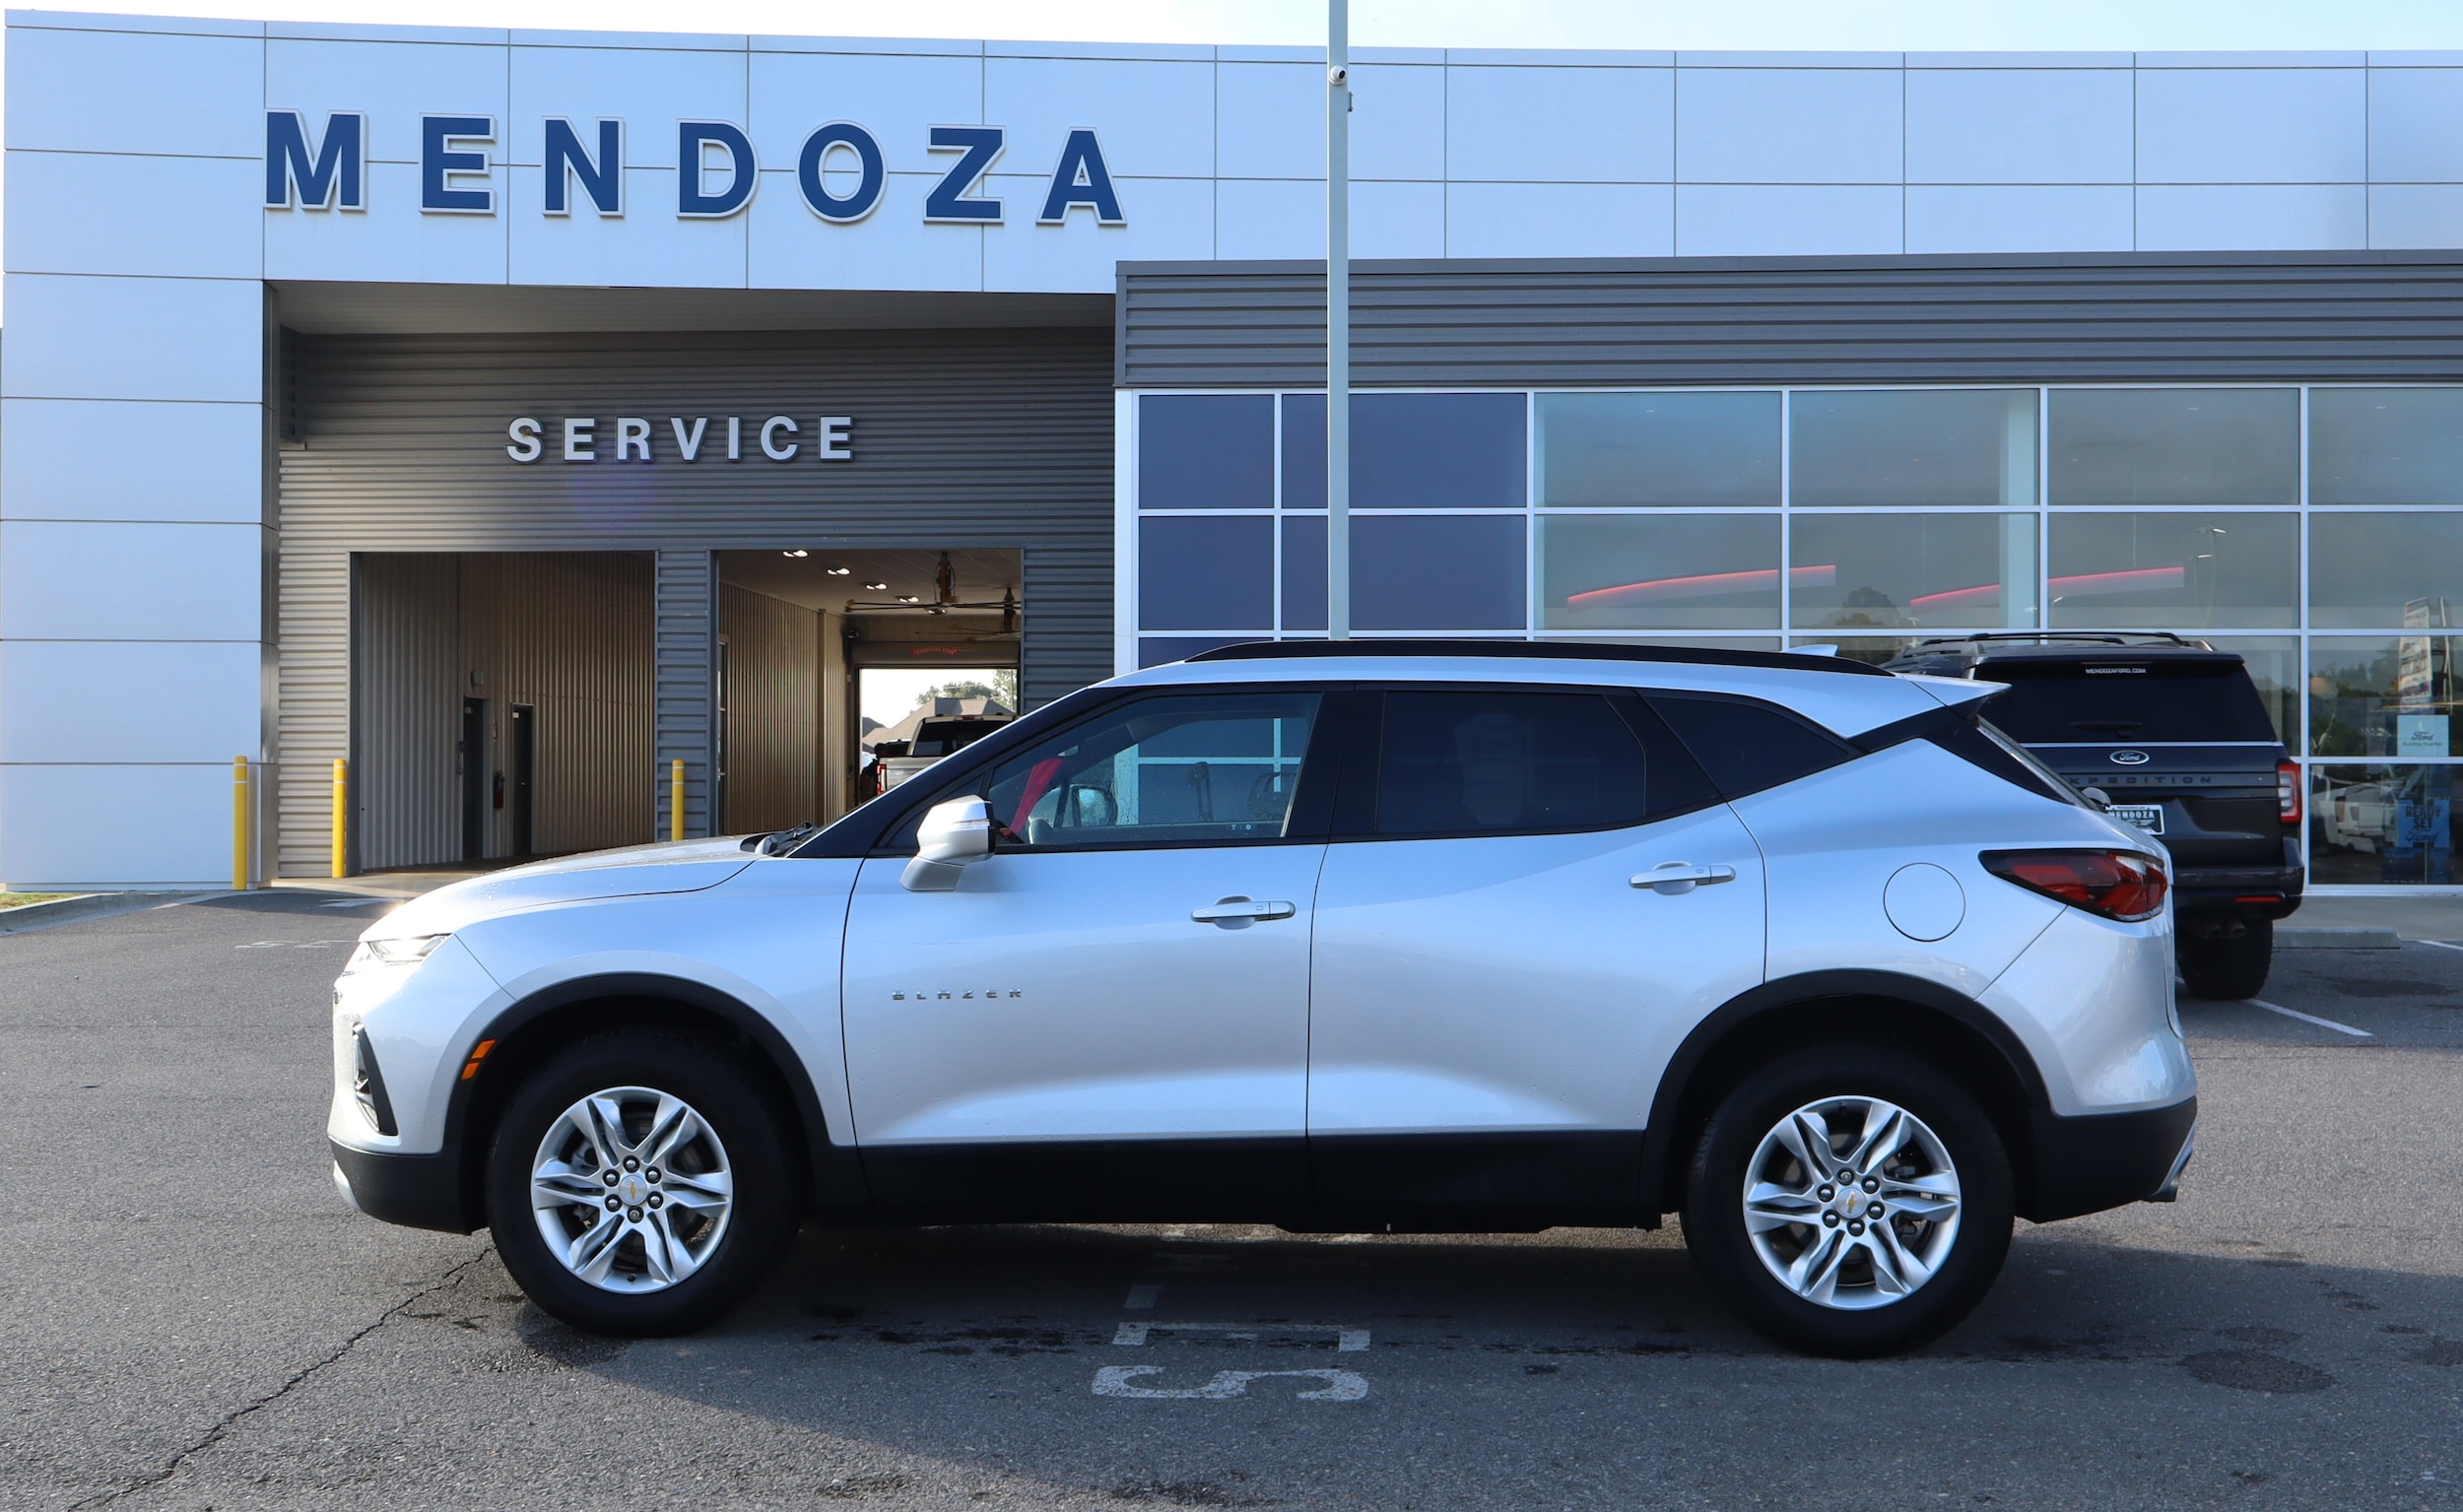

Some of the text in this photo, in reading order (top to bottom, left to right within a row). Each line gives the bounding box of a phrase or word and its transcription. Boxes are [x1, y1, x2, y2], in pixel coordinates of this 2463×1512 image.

[264, 108, 1127, 225] MENDOZA
[505, 415, 853, 464] SERVICE
[2412, 732, 2434, 741] Ford
[2405, 806, 2441, 818] READY
[2414, 818, 2432, 829] SET
[2406, 829, 2438, 842] Ford
[892, 988, 1022, 1001] BLAZER
